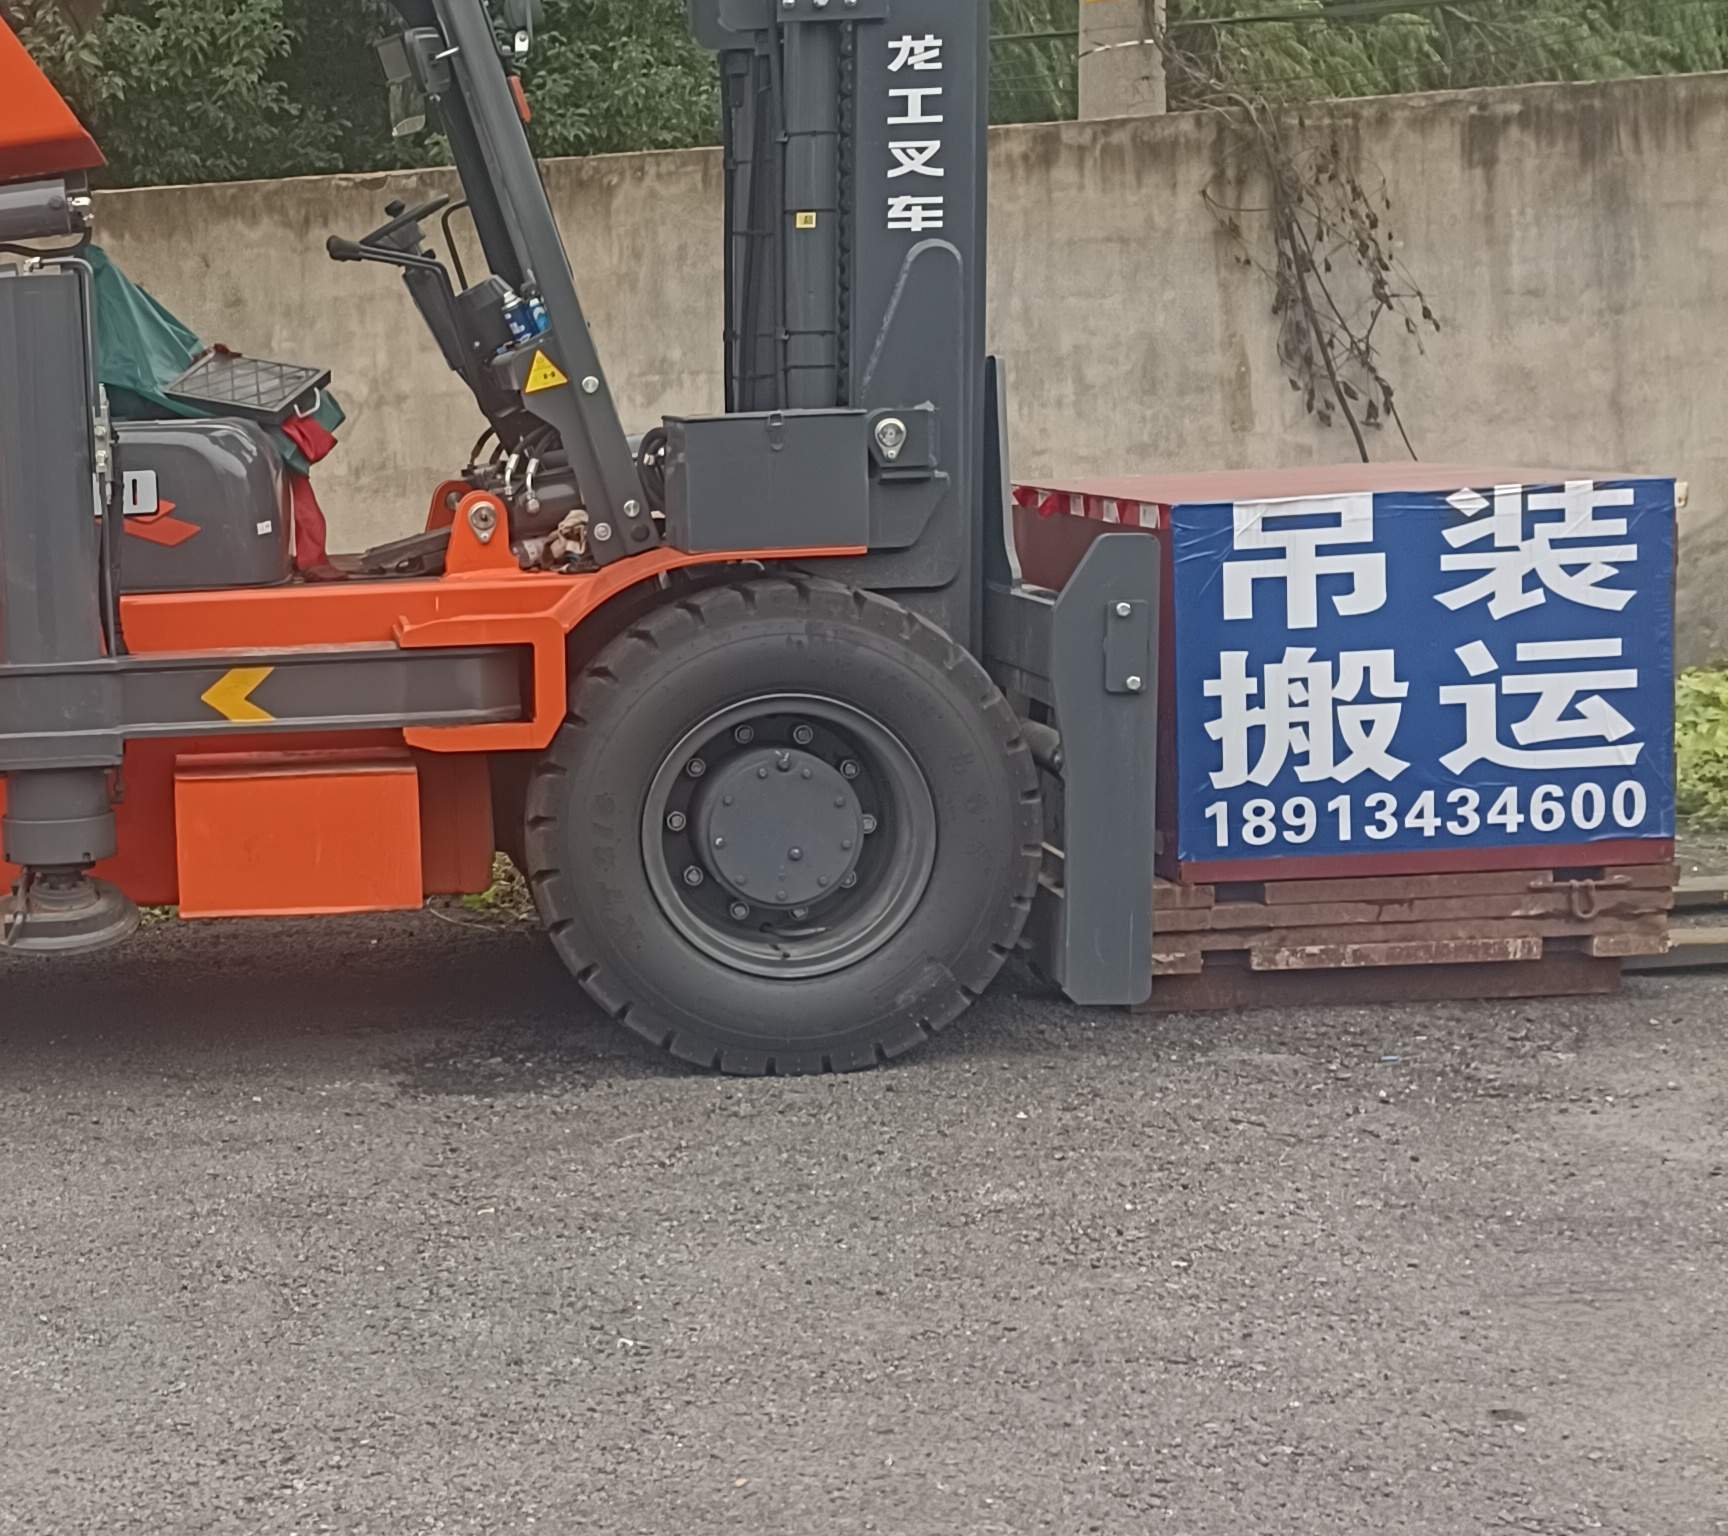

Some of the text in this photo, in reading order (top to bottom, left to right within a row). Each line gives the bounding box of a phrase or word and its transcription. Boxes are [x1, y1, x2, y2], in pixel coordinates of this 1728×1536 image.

[886, 33, 944, 232] 龙工叉车
[1221, 478, 1639, 629] 吊装
[1203, 637, 1646, 791] 搬运
[1204, 780, 1648, 849] 18913434600
